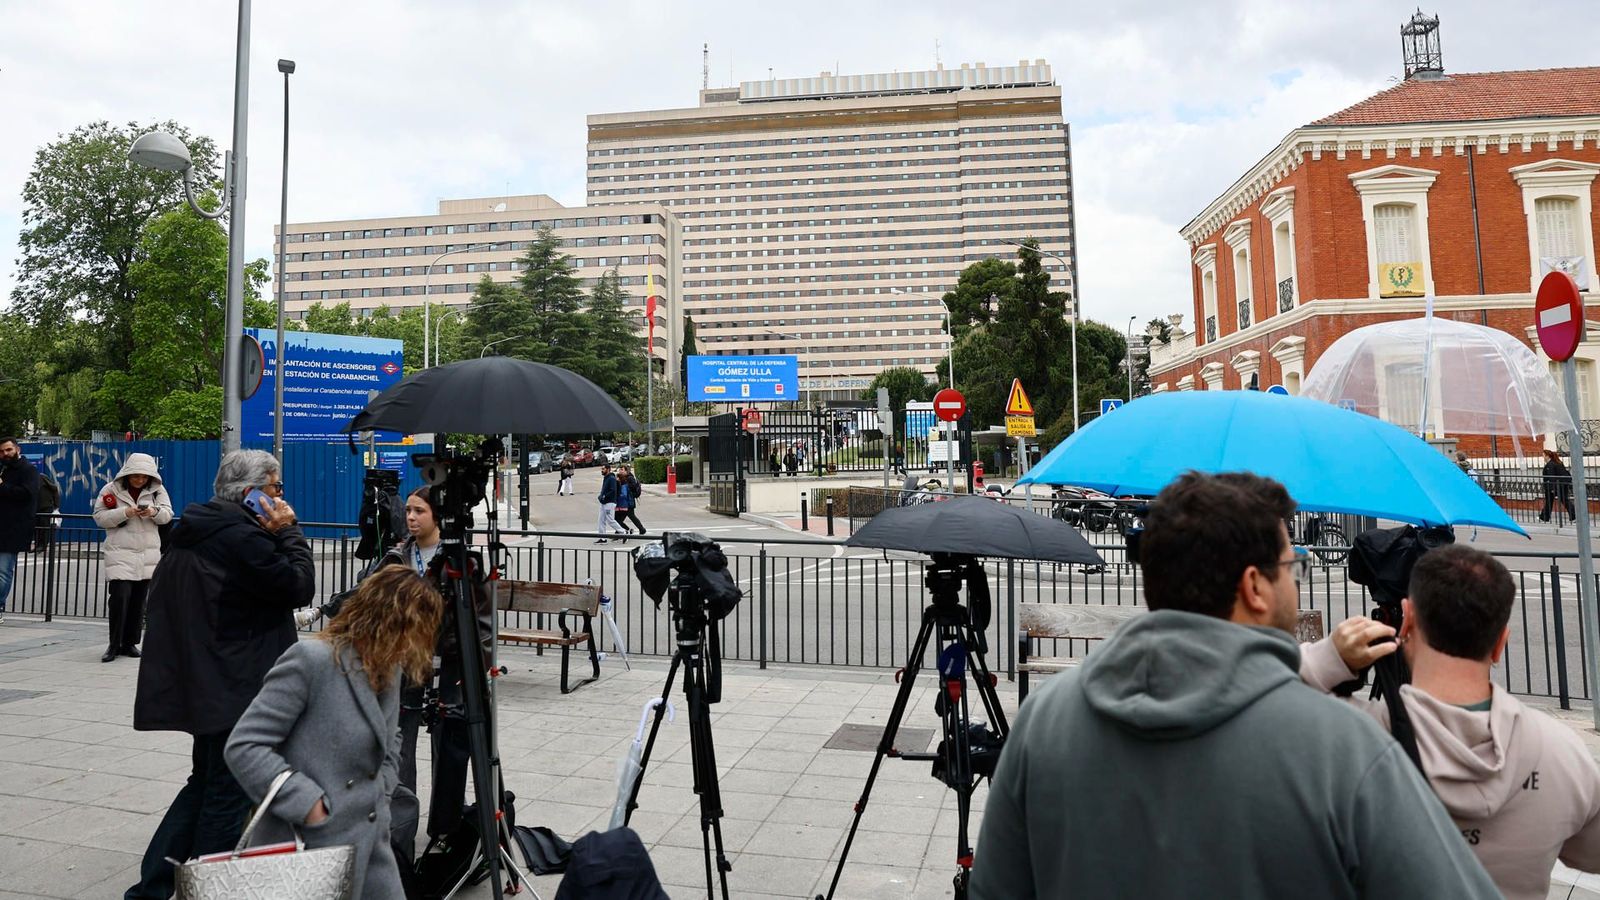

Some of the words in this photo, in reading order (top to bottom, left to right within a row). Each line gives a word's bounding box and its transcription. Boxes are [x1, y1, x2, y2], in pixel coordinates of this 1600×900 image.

[332, 362, 376, 371] ASCENSORES
[718, 366, 748, 376] GÓMEZ
[332, 372, 380, 381] CARABANCHEL
